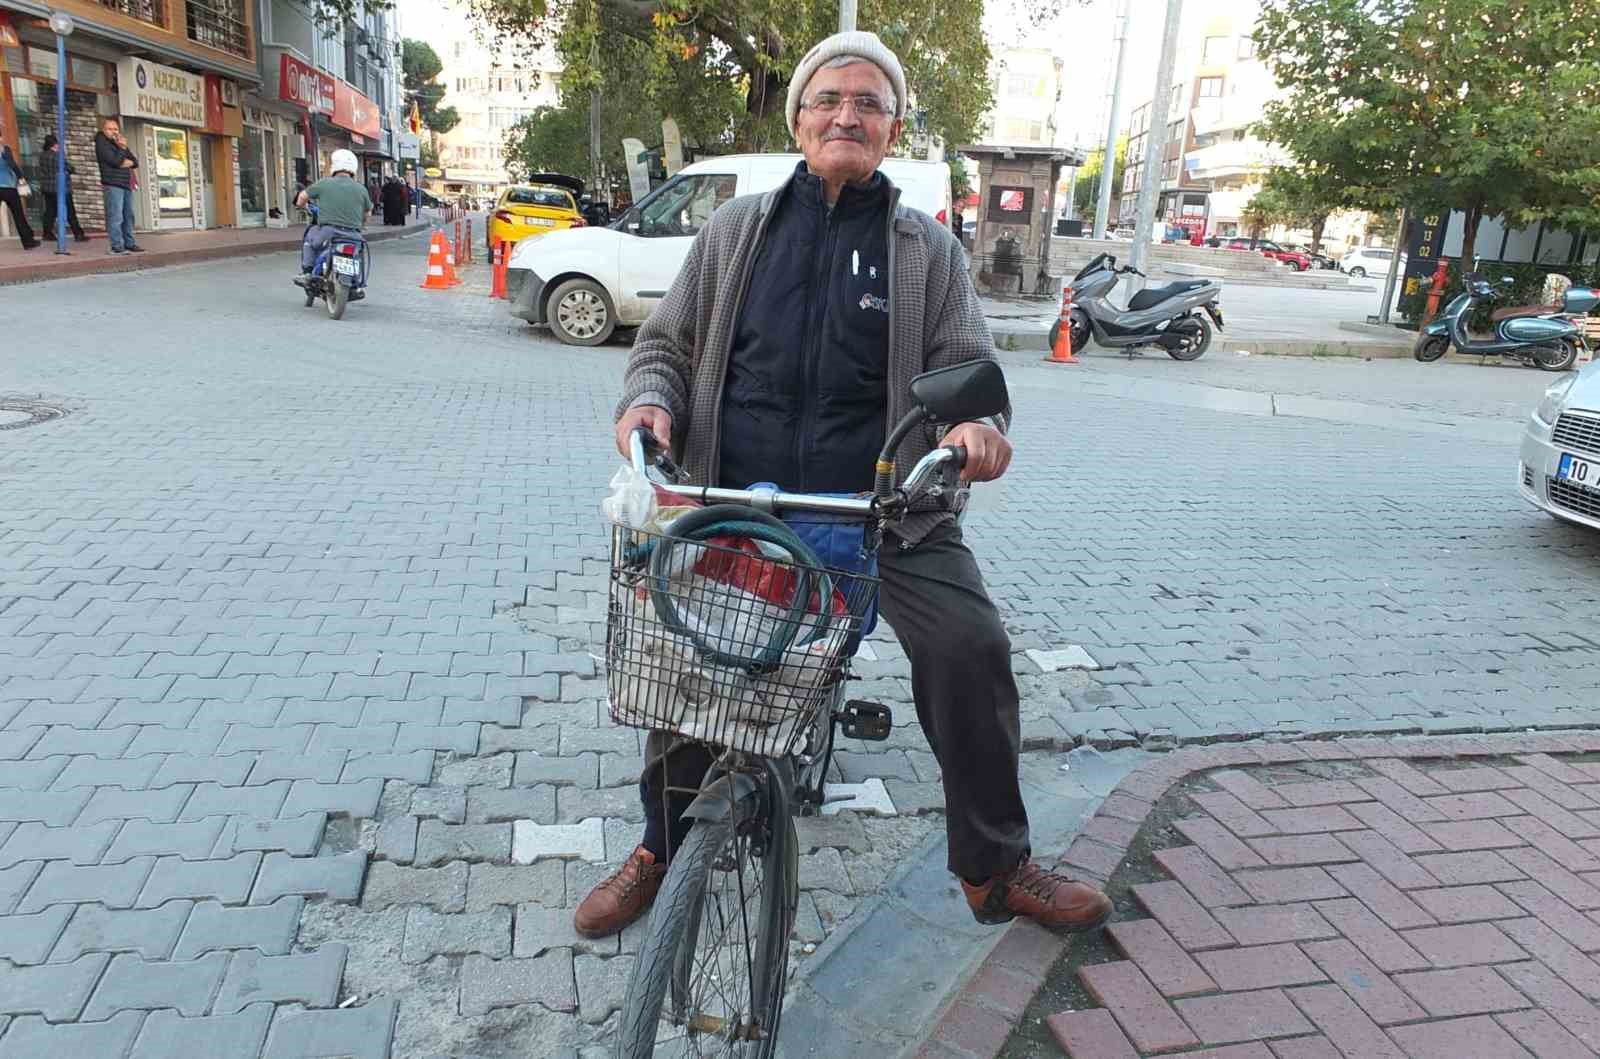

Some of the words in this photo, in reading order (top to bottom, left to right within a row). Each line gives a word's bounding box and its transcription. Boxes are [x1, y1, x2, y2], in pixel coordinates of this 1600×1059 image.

[153, 70, 188, 95] NAZAR
[1423, 230, 1433, 241] 13
[1418, 246, 1431, 257] 02
[1571, 460, 1588, 481] 10
